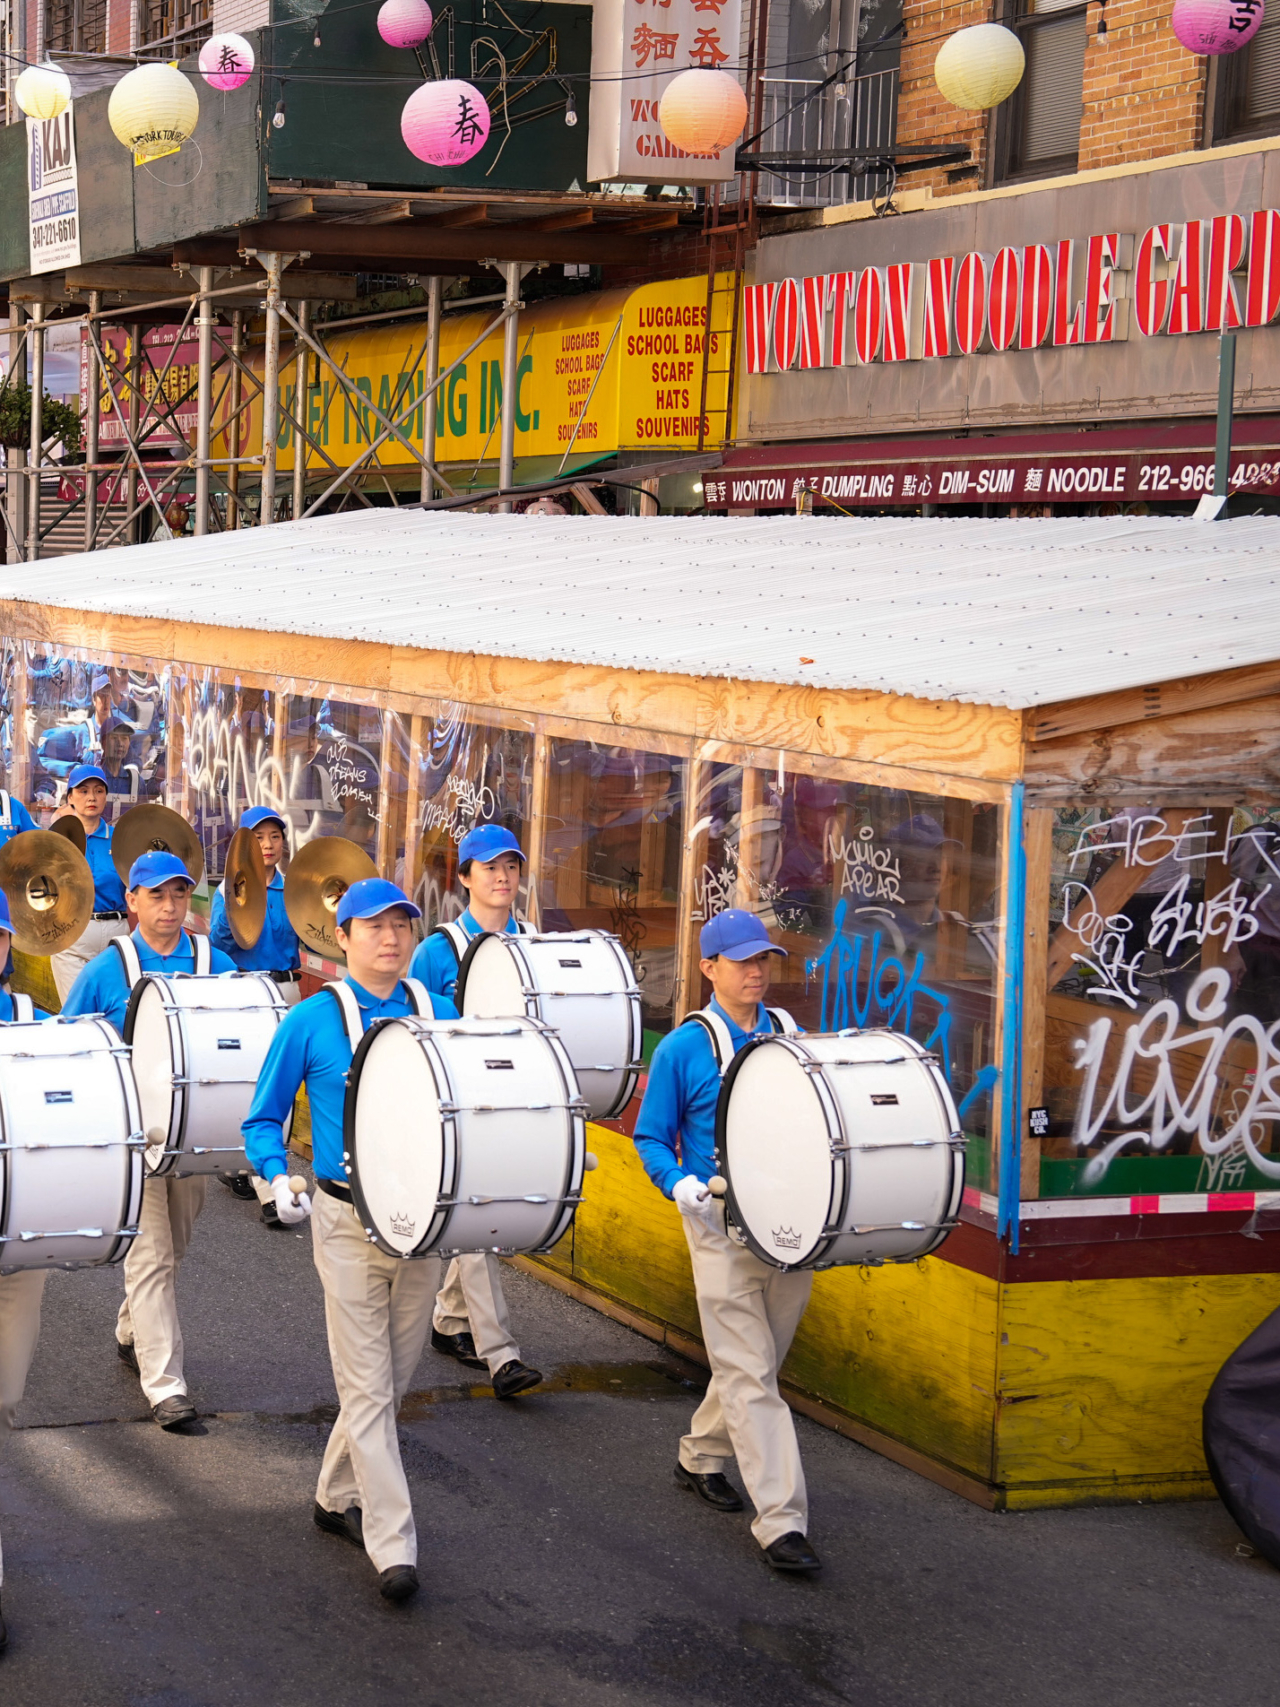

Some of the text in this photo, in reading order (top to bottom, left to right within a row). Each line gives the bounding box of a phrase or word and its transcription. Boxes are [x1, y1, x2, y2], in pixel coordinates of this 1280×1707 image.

[217, 45, 242, 73] 春
[450, 94, 484, 145] 春
[42, 112, 70, 172] KAJ
[32, 217, 76, 249] 347-221-6610
[743, 209, 1280, 374] WONTON NOODLE GARD
[639, 305, 708, 328] LUGGAGES
[562, 331, 600, 352] LUGGAGES
[627, 334, 680, 356] SCHOOL
[555, 356, 583, 375] SCHOOL
[651, 361, 694, 382] SCARF
[567, 377, 591, 396] SCARF
[340, 362, 467, 445] TRADING
[480, 354, 540, 434] INC.
[656, 388, 690, 410] HATS
[732, 478, 786, 502] WONTON
[821, 473, 894, 498] DUMPLING
[901, 474, 933, 497] 點心
[938, 469, 1015, 495] DIM-SUM
[1023, 467, 1043, 492] 麵
[1047, 466, 1126, 493] NOODLE
[41, 917, 80, 946] Zildjian
[393, 1223, 412, 1236] REMO
[776, 1236, 798, 1247] REMO
